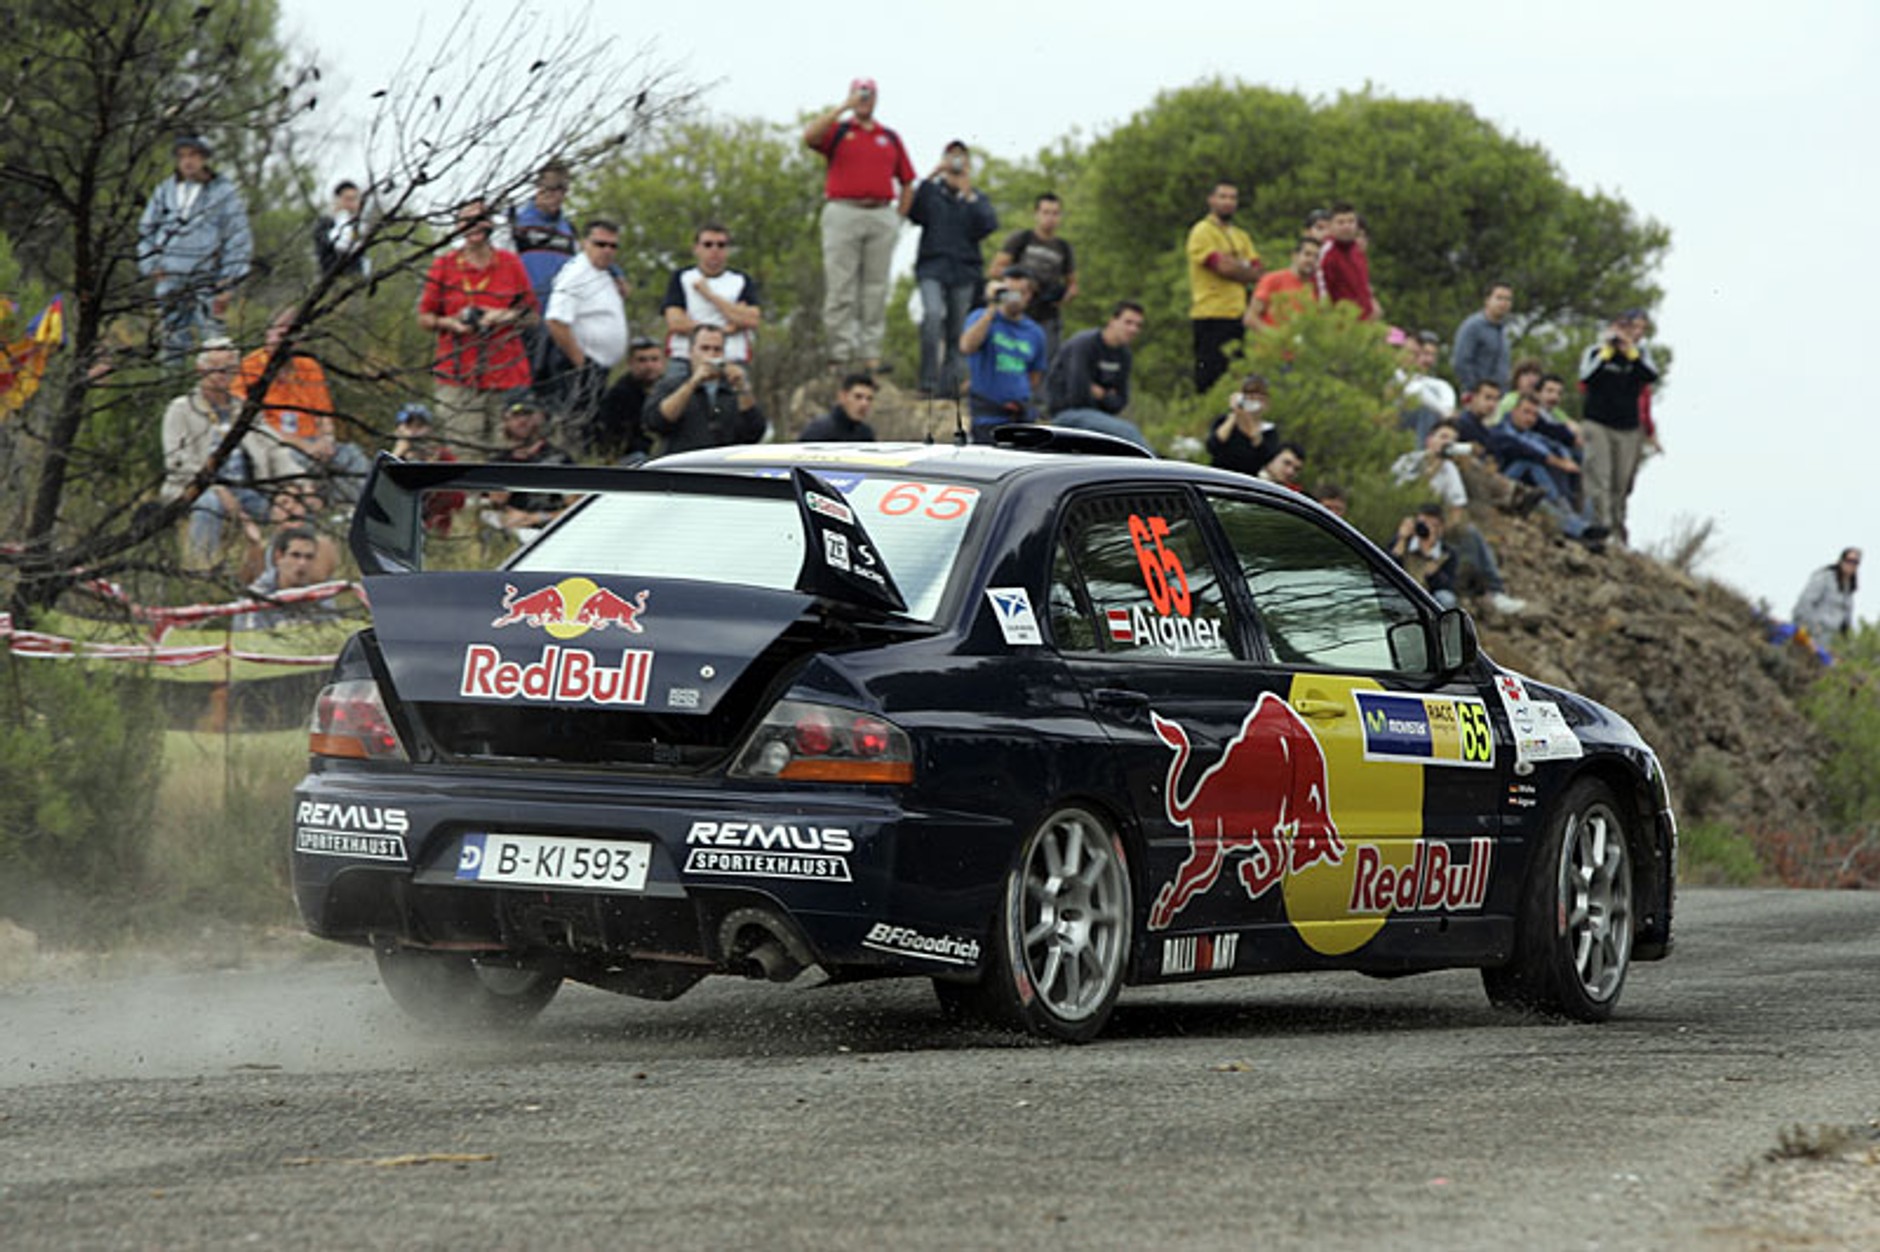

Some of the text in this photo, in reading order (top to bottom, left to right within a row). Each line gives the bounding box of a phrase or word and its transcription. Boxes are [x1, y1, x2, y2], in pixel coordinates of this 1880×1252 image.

[878, 482, 977, 521] 65
[1127, 513, 1192, 618] 65
[1132, 603, 1221, 656] Aigner
[460, 644, 654, 706] Red Bull
[1457, 702, 1491, 762] 65
[296, 800, 410, 832] REMUS
[300, 833, 398, 855] SPORTEXHAUST
[686, 821, 855, 852] REMUS
[459, 844, 481, 871] D
[570, 847, 632, 882] 593
[696, 854, 840, 876] SPORTEXHAUST
[1348, 837, 1491, 914] Red Bull
[866, 922, 980, 960] BFGoodrich
